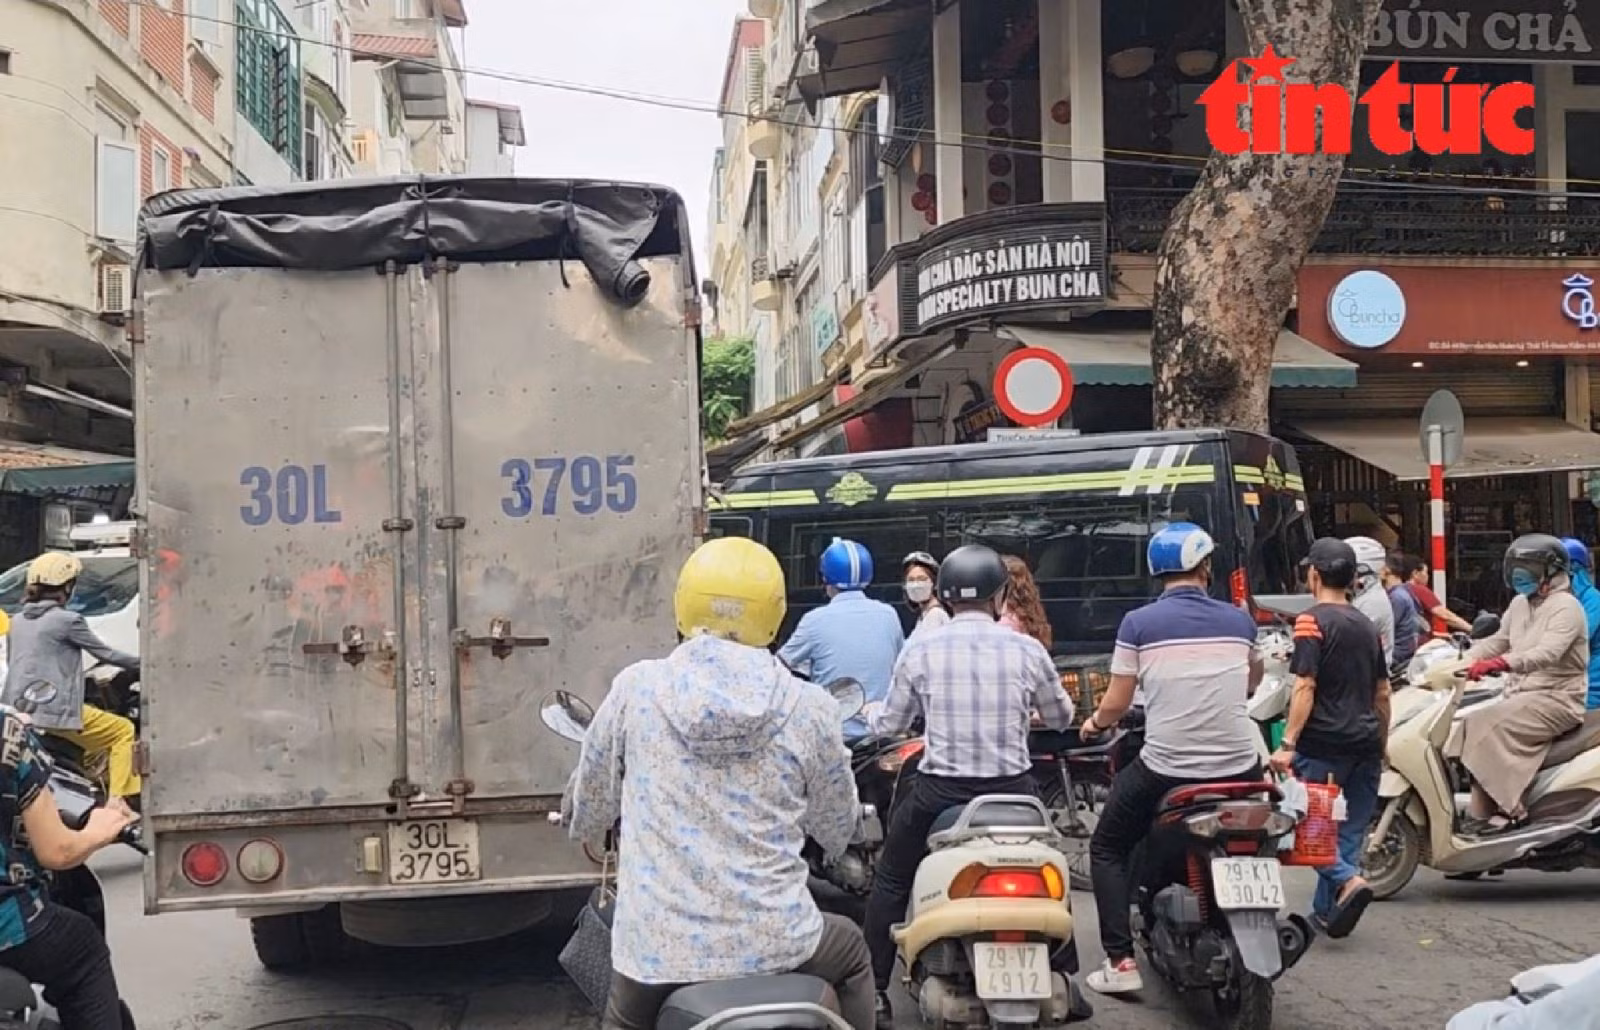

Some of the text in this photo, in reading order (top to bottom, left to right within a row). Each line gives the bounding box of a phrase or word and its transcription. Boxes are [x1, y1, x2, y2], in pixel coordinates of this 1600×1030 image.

[1367, 0, 1593, 52] BÚN CHẢ
[1026, 234, 1053, 270] HÀ
[1056, 234, 1091, 271] NỘI
[936, 277, 1013, 316] SPECIALTY
[1016, 273, 1057, 301] BUN
[1060, 270, 1101, 298] CHA
[239, 455, 638, 526] 30L 3795
[407, 822, 461, 850] 30L
[398, 850, 470, 880] 3795
[986, 946, 1038, 970] 29-V7
[988, 971, 1041, 995] 4912
